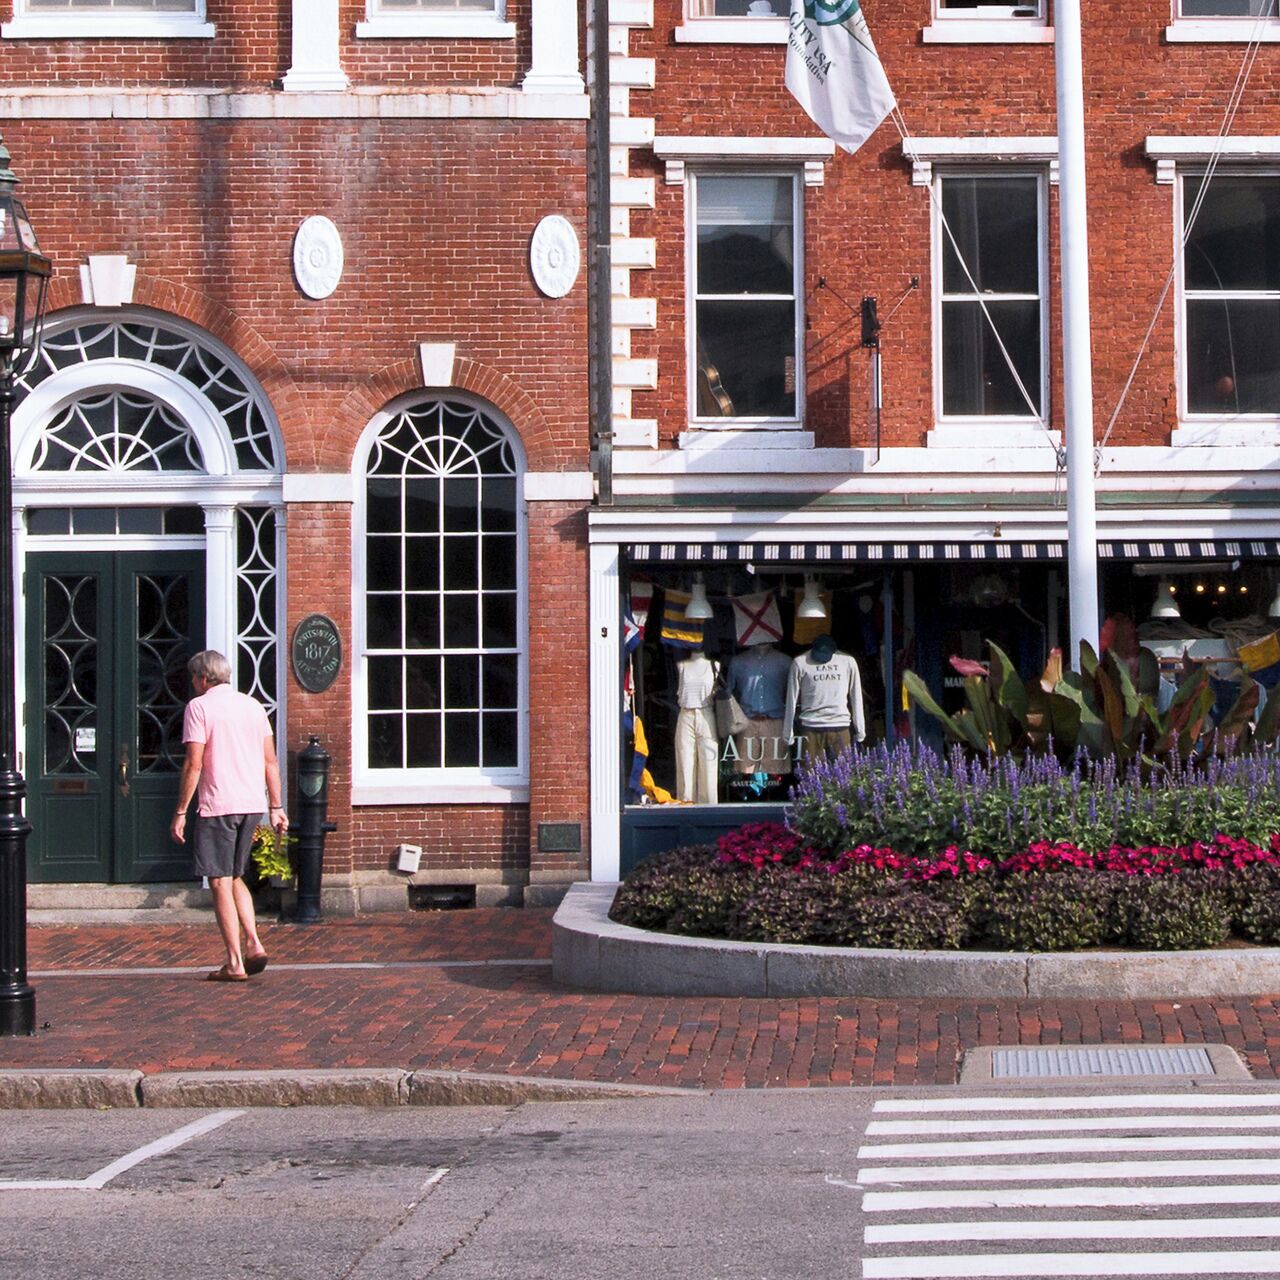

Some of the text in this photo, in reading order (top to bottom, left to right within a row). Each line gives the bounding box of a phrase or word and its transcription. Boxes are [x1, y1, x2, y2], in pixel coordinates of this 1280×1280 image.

[790, 12, 817, 46] CITY
[305, 642, 332, 665] 1817
[700, 735, 809, 762] SAULT
